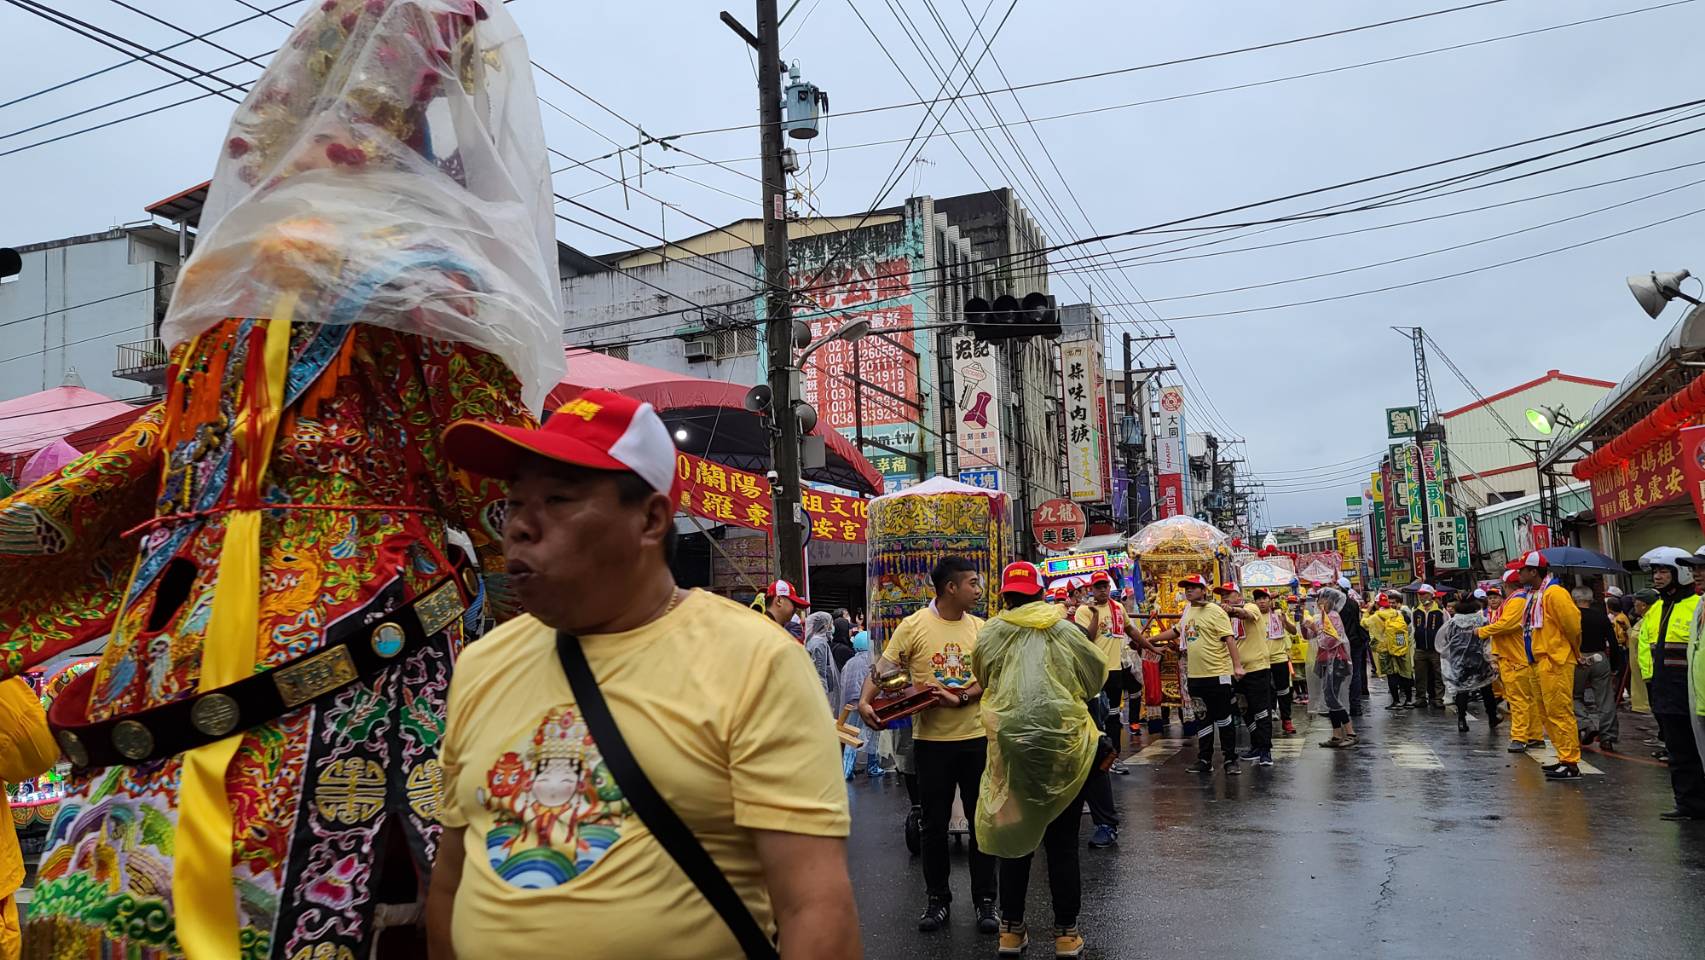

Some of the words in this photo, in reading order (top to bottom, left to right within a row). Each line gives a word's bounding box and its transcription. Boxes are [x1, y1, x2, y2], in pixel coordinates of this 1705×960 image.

[811, 311, 900, 337] 最大最好
[824, 344, 903, 364] (04)2260555
[1168, 415, 1178, 437] 大同
[1039, 502, 1077, 522] 九龍
[1043, 528, 1077, 544] 美髮
